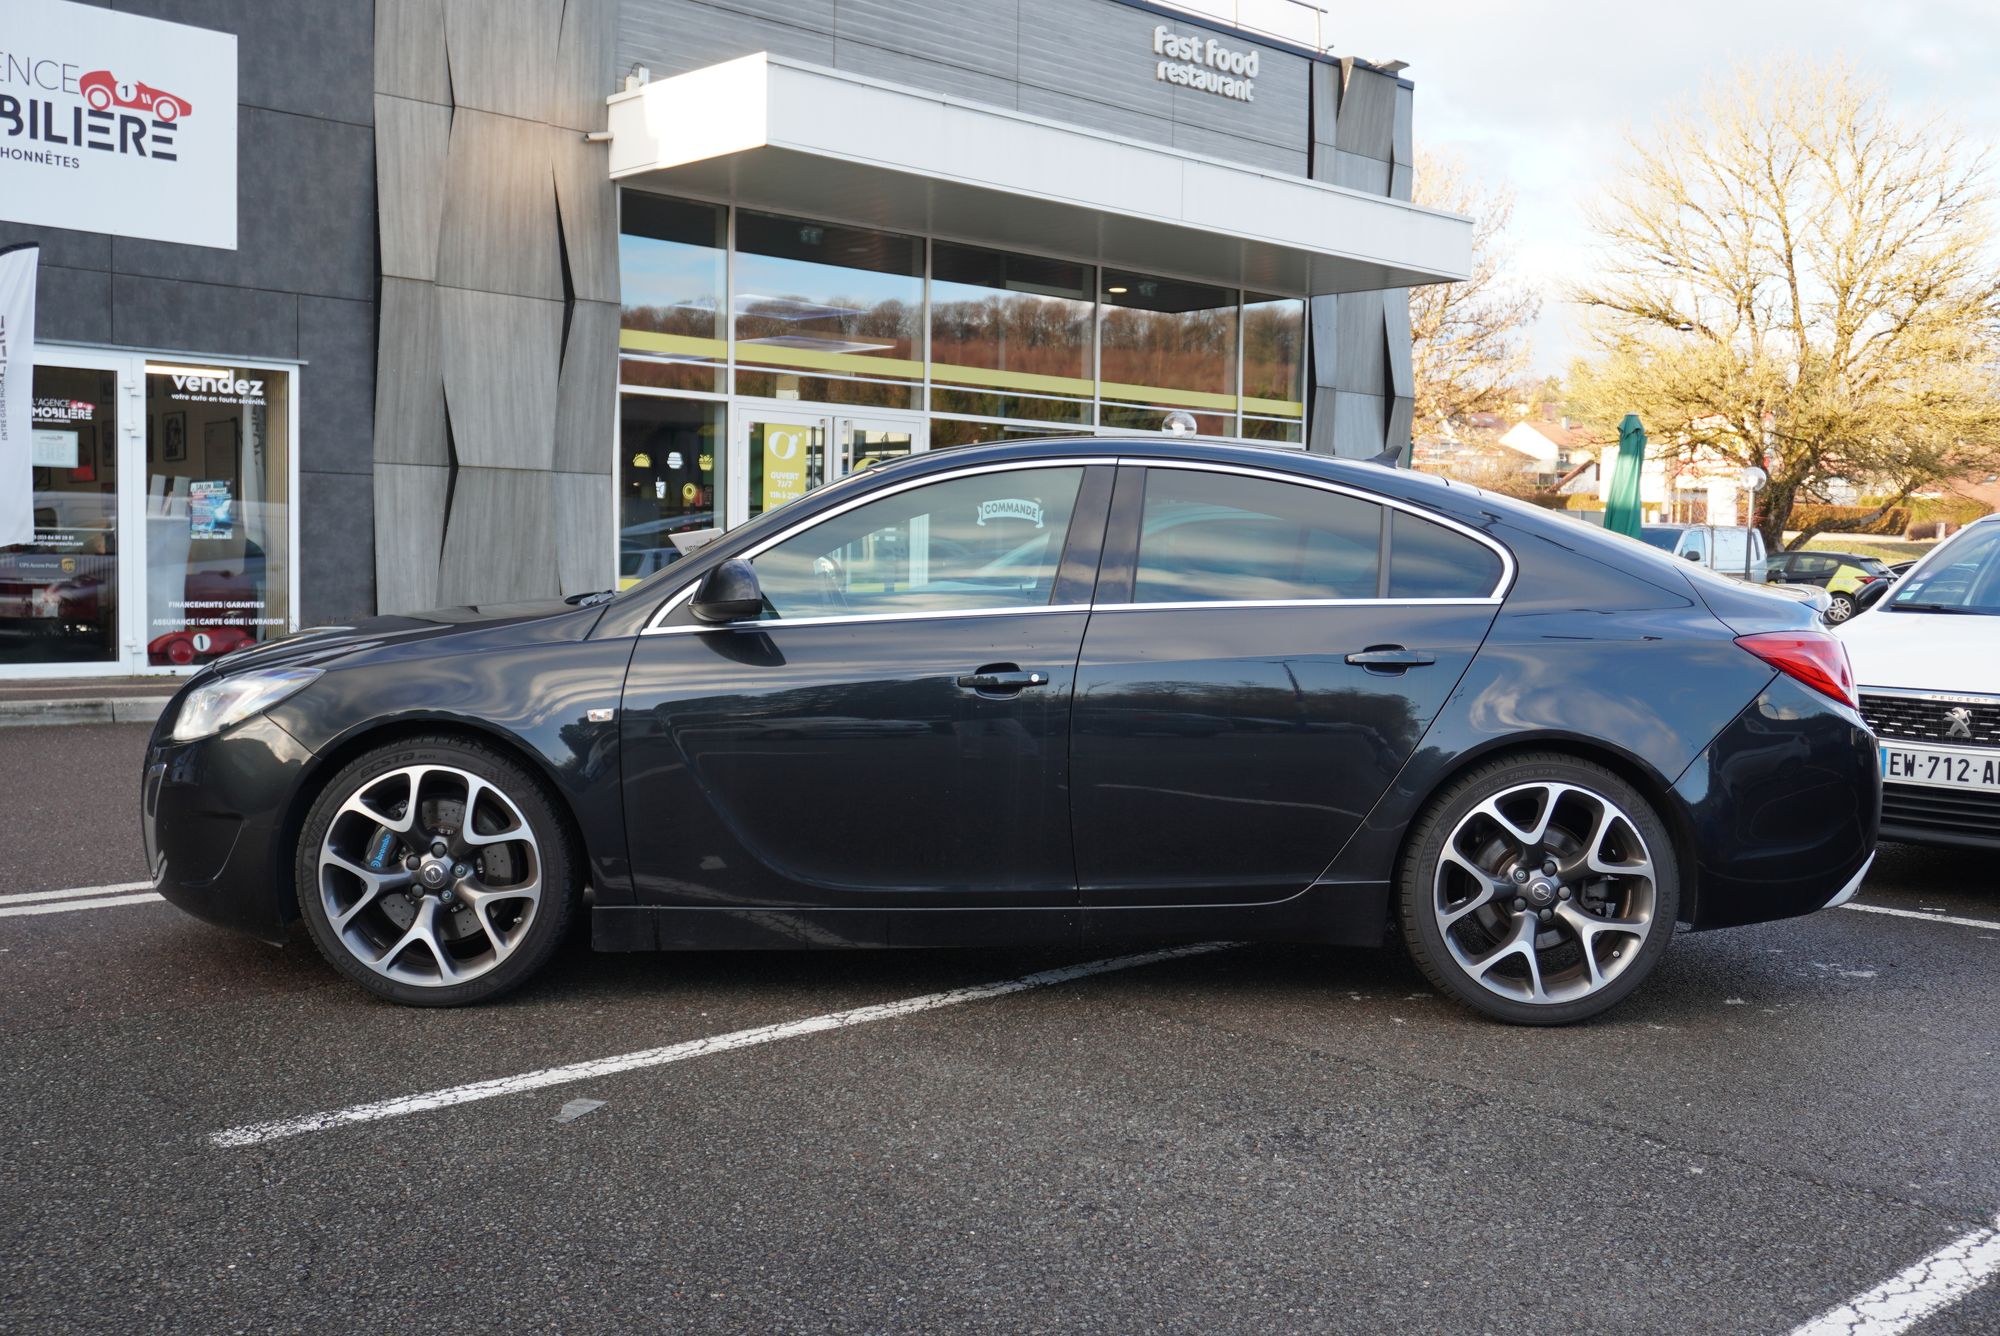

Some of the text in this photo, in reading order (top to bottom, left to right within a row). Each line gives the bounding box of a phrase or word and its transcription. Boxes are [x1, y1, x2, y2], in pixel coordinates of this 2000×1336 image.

[1153, 25, 1259, 78] fast food
[1156, 61, 1255, 102] restaurant
[0, 146, 80, 169] HONNÊTES
[172, 369, 264, 396] vendez
[191, 394, 207, 402] auto
[219, 396, 237, 404] toute
[984, 502, 1038, 519] COMMANDE
[168, 601, 265, 609] FINANCEMENTS GARANTIES
[152, 618, 195, 626] ASSURANCE
[199, 618, 223, 626] CARTE
[223, 618, 244, 626] GRISE
[1889, 752, 2000, 785] EW-712-A
